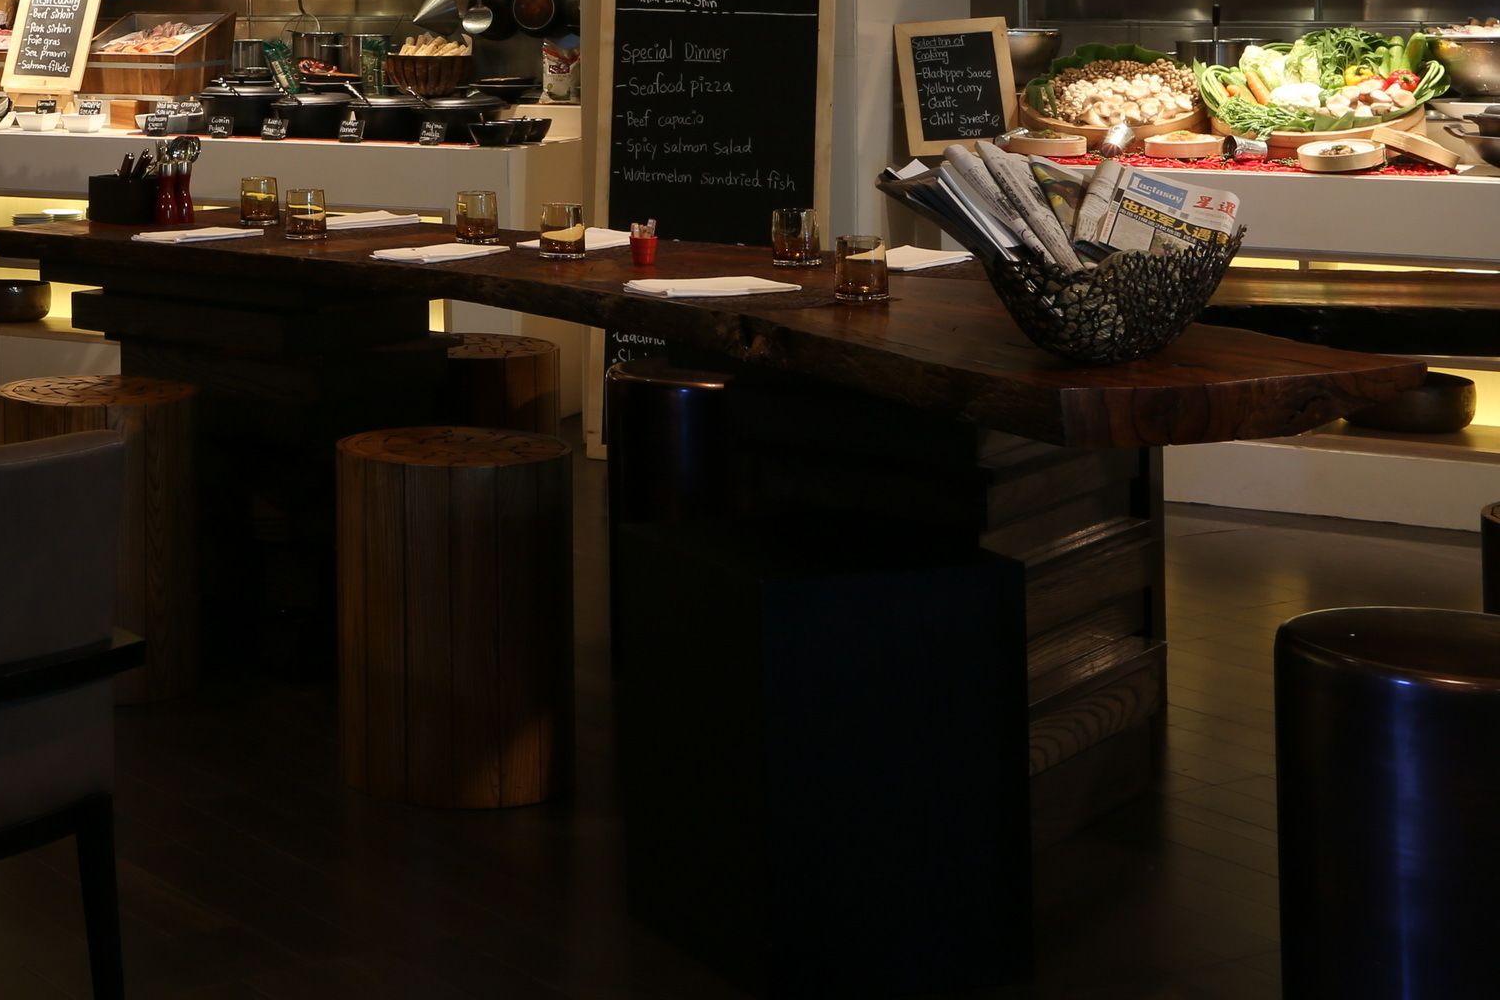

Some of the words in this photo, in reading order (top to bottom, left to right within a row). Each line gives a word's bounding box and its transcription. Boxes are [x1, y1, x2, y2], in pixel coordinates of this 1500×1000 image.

[33, 7, 50, 19] Beef
[50, 8, 74, 20] sirloin
[30, 21, 45, 33] Pork
[46, 23, 71, 34] sirloin
[28, 34, 42, 45] Foie
[43, 38, 60, 50] gras
[953, 34, 966, 47] of
[25, 47, 38, 57] Sea
[40, 50, 66, 60] prawn
[621, 39, 673, 64] Special
[684, 42, 730, 61] Dinner
[915, 48, 949, 65] Cooking
[21, 60, 47, 70] Salmon
[48, 60, 70, 72] fillets
[966, 66, 992, 79] Sauce
[629, 72, 685, 96] Seafood
[691, 76, 733, 97] pizza
[923, 83, 955, 96] Yellow
[928, 96, 959, 109] Garlic
[627, 109, 652, 127] Beef
[930, 111, 954, 126] Chili
[627, 137, 658, 160] Spicy
[624, 166, 692, 183] Watermelon
[767, 170, 795, 192] fish
[1130, 177, 1183, 203] Lactasoy
